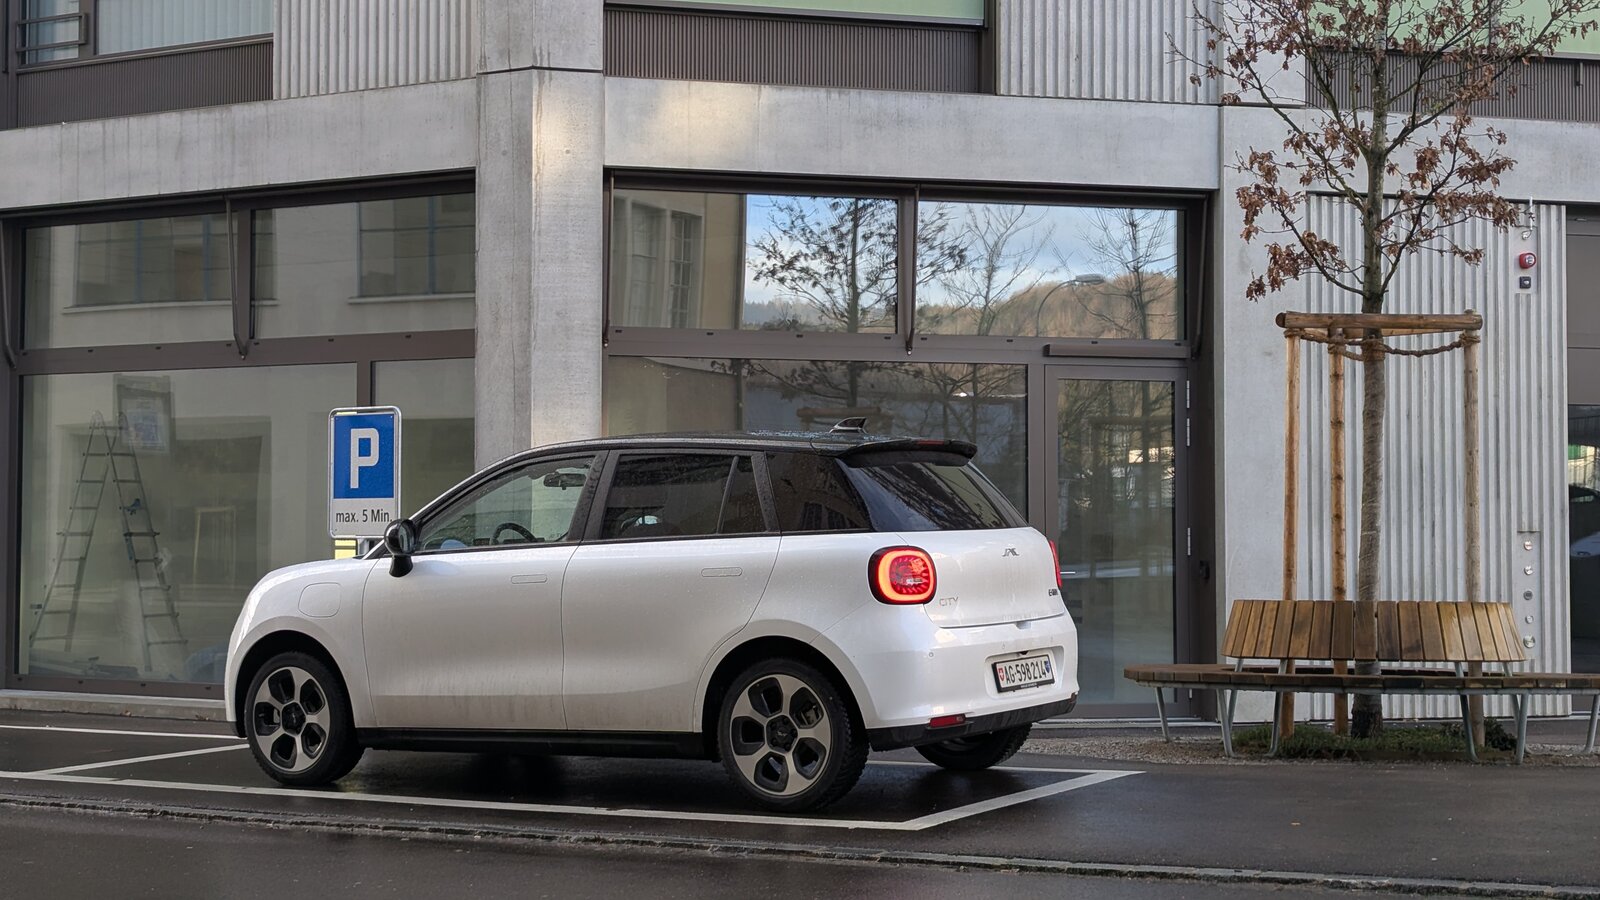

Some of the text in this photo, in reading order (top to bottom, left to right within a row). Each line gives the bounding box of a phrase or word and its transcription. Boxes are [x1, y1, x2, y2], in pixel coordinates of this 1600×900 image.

[350, 428, 379, 489] P
[335, 508, 393, 523] max. 5 Min.
